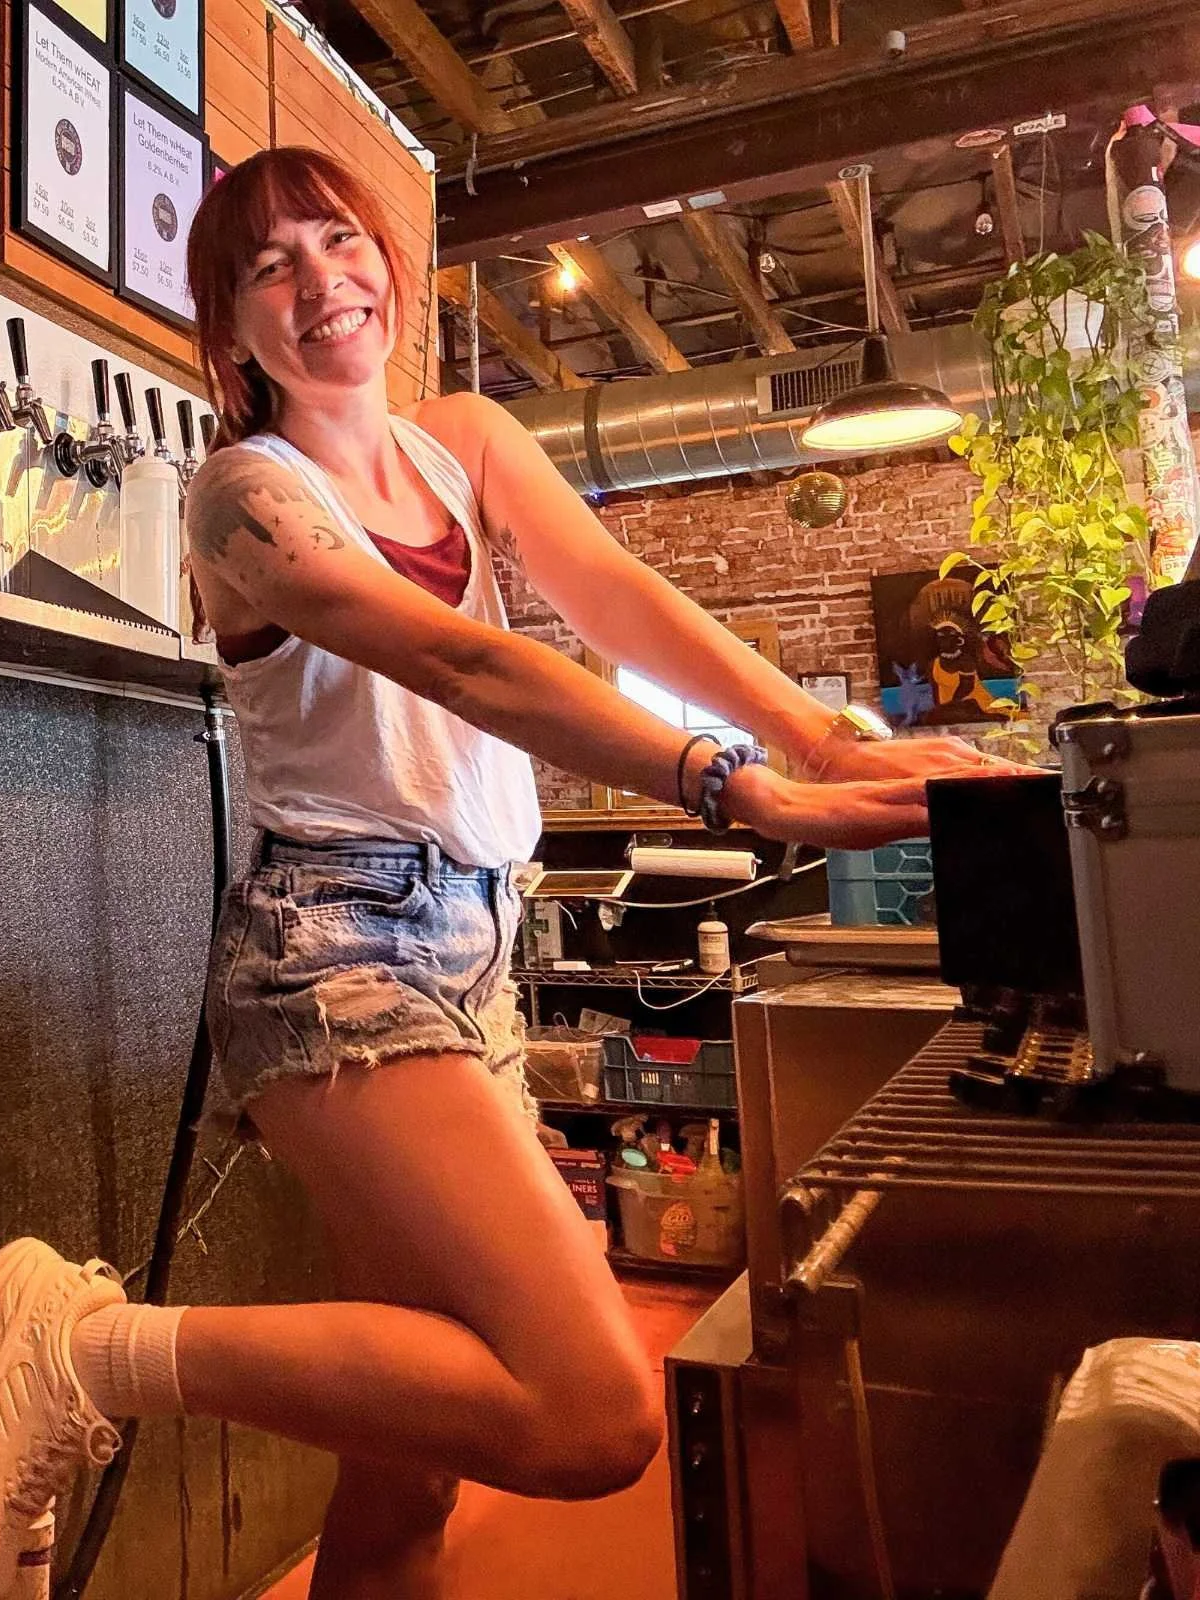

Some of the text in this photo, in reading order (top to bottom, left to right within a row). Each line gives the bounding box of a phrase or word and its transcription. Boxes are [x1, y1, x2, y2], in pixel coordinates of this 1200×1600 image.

[35, 30, 48, 51] Let
[51, 41, 73, 70] Them
[134, 112, 145, 131] Let
[147, 121, 168, 145] Them
[568, 1183, 598, 1193] INERS
